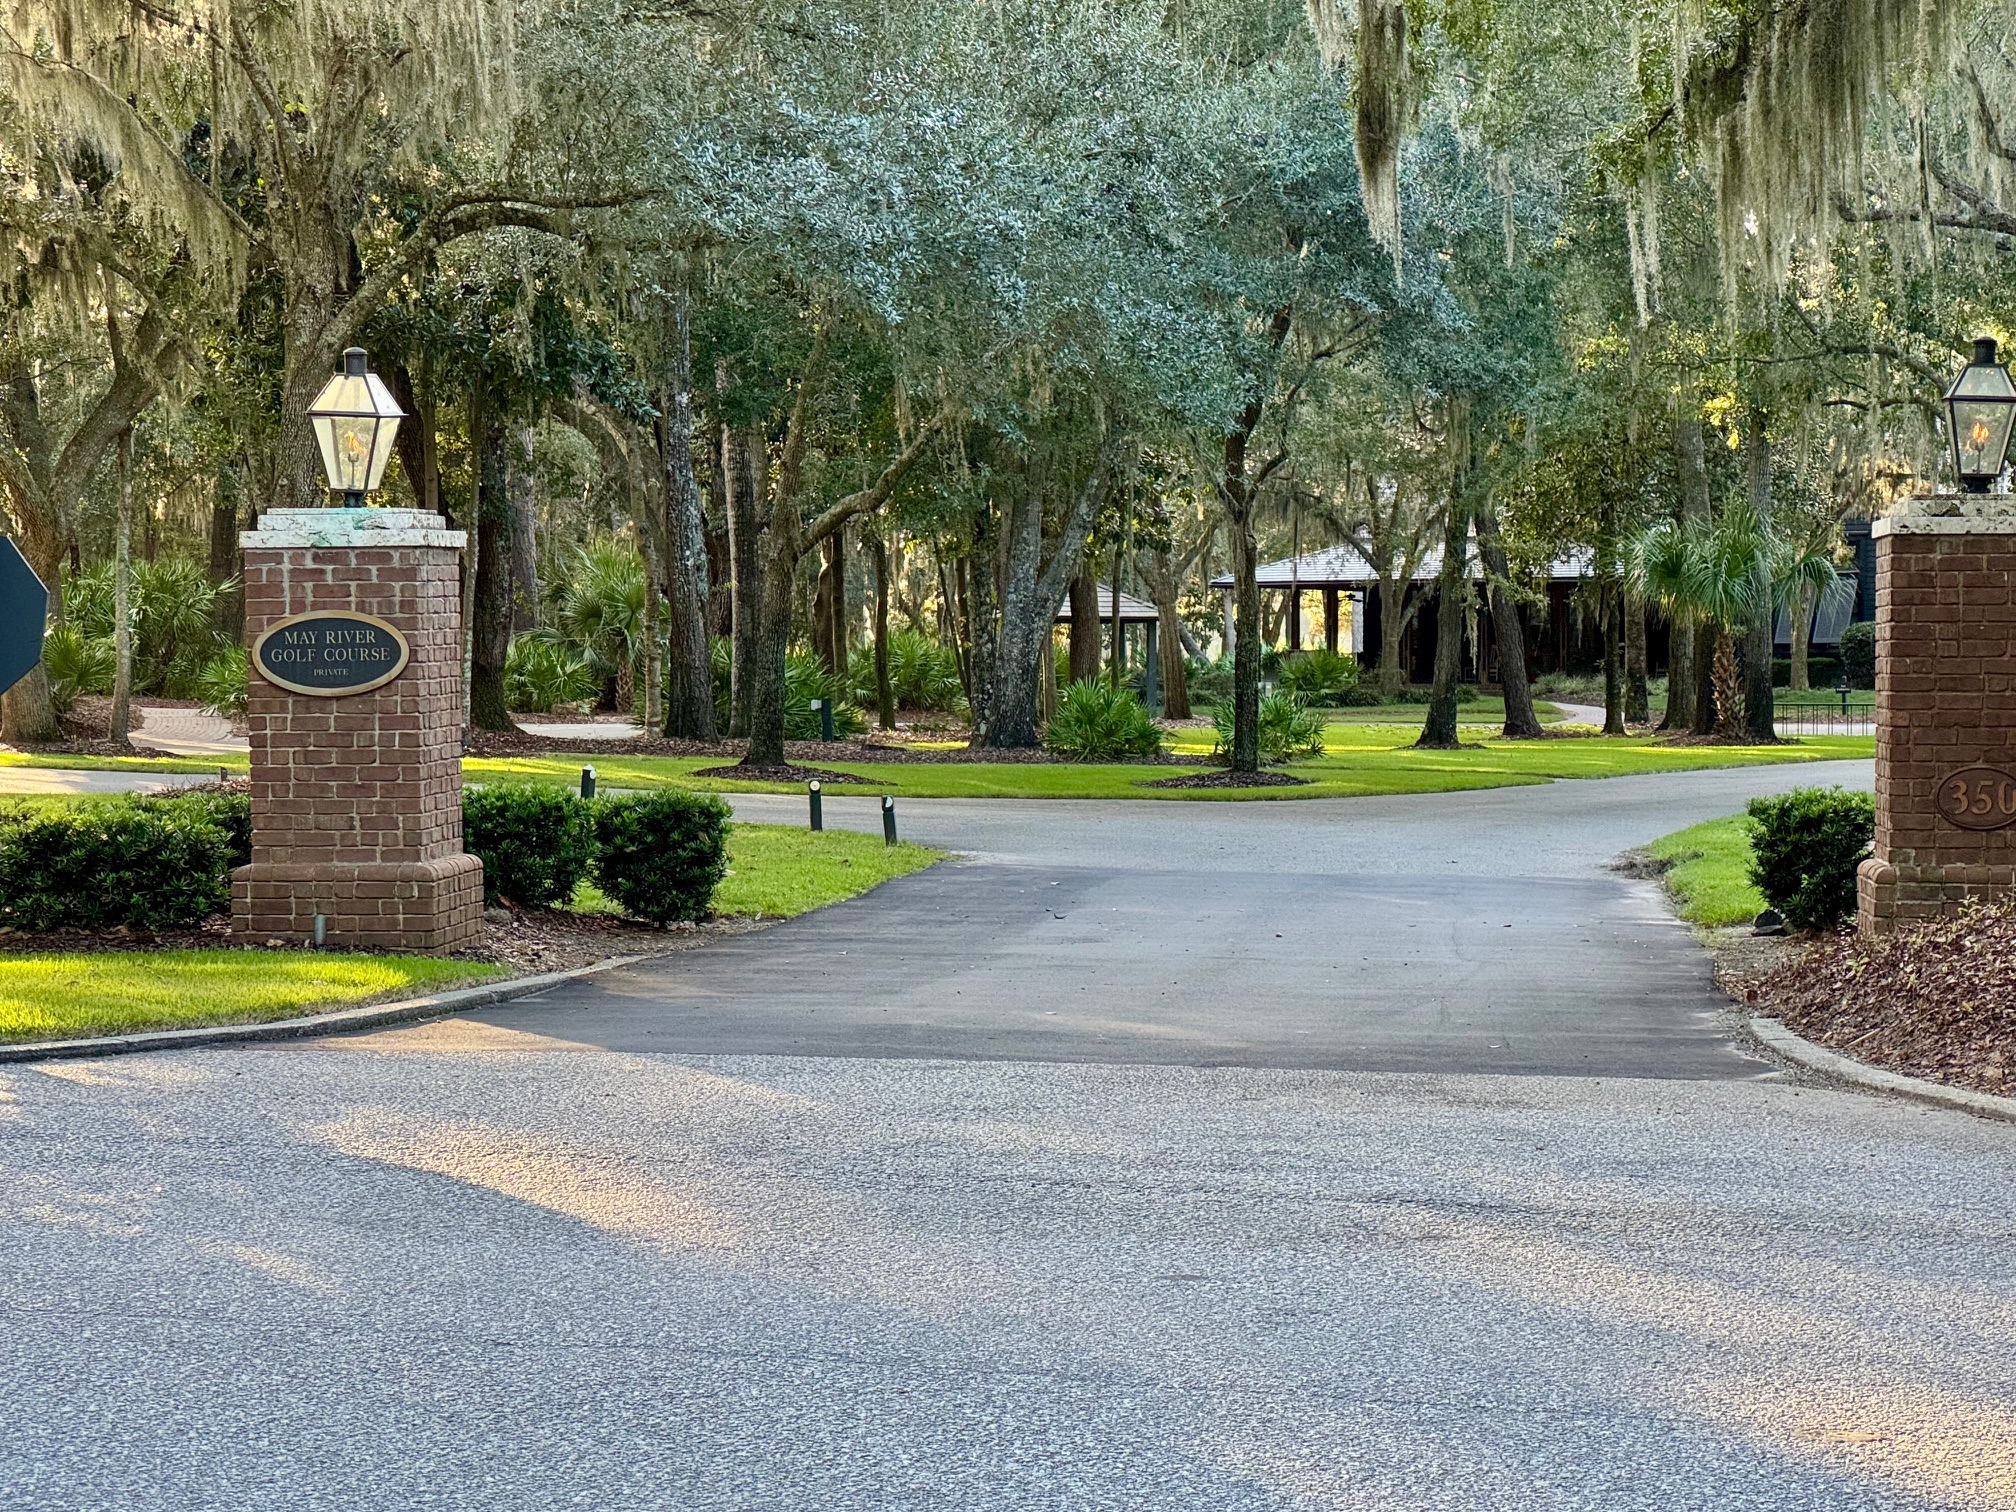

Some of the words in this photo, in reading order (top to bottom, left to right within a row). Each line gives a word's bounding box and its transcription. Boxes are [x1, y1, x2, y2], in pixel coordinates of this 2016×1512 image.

[284, 631, 318, 644] MAY
[325, 629, 376, 644] RIVER
[271, 648, 316, 662] GOLF
[323, 647, 390, 662] COURSE
[313, 668, 349, 676] PRIVATE
[1949, 780, 2016, 815] 350
